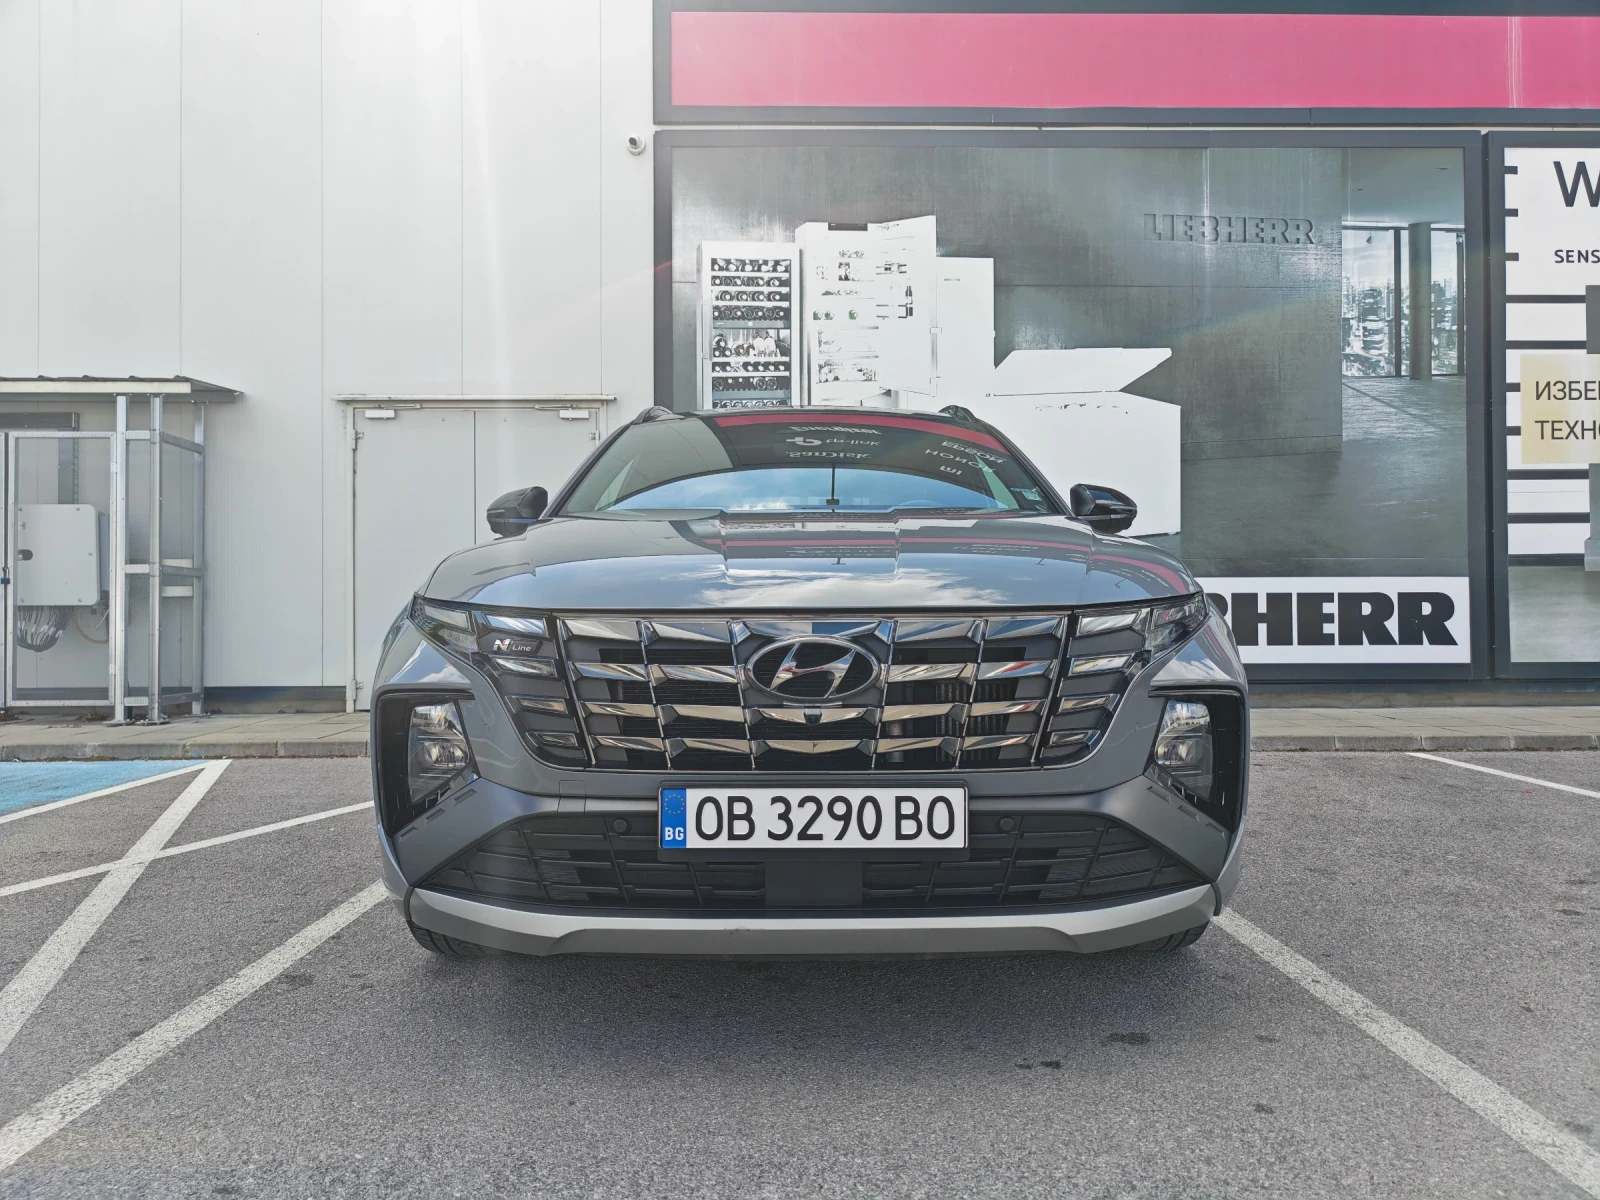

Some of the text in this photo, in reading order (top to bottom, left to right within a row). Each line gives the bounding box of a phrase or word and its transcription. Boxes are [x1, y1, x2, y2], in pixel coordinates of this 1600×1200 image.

[1143, 213, 1315, 244] LIEBHERR
[1535, 380, 1600, 401] ИЗБЕ
[695, 795, 955, 841] OB 3290 BO
[664, 826, 685, 840] BG
